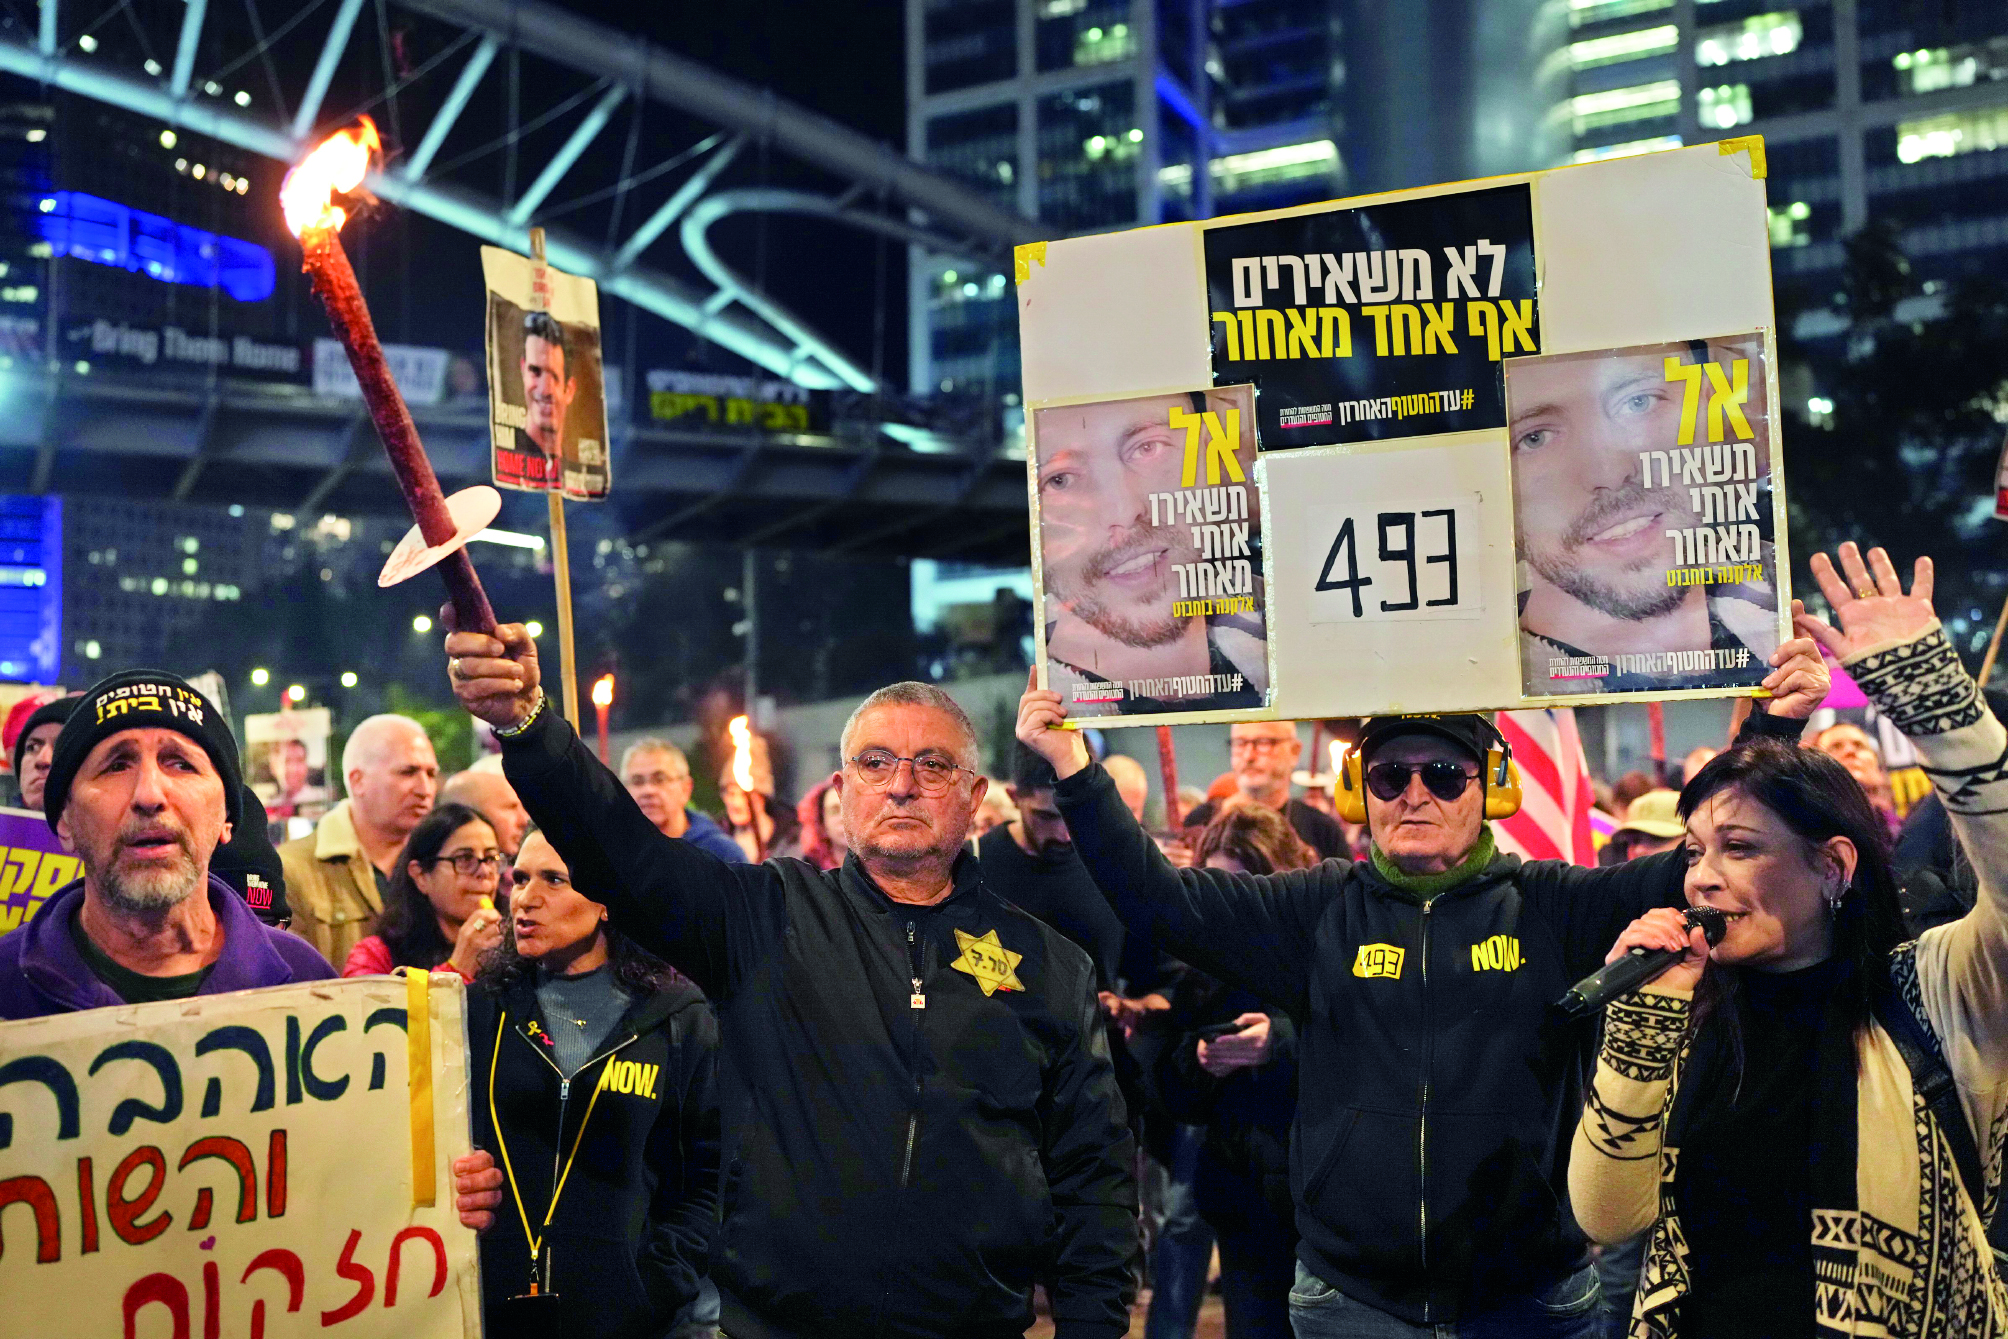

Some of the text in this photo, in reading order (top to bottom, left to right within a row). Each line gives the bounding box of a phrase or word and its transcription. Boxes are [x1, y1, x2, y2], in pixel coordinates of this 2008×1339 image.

[1231, 239, 1507, 308] לא משאירים
[1211, 299, 1538, 362] אף אחד מאחור
[1664, 356, 1755, 446] אל
[1169, 406, 1246, 488] אל
[1639, 442, 1757, 489] תשאירו
[1148, 485, 1249, 527] תשאירו
[1689, 482, 1760, 524] אותי
[1190, 521, 1251, 560] אותי
[1665, 523, 1761, 566] מאחור
[1171, 558, 1253, 598] מאחור
[1314, 508, 1459, 618] 493
[1666, 563, 1764, 587] אלקנה בוחבוט
[1172, 596, 1254, 618] אלקנה בוחבוט
[96, 683, 202, 709] אין חטופים
[96, 696, 203, 726] אין בית!
[246, 886, 273, 906] NOW
[1471, 934, 1527, 972] NOW.
[601, 1060, 660, 1100] NOW.
